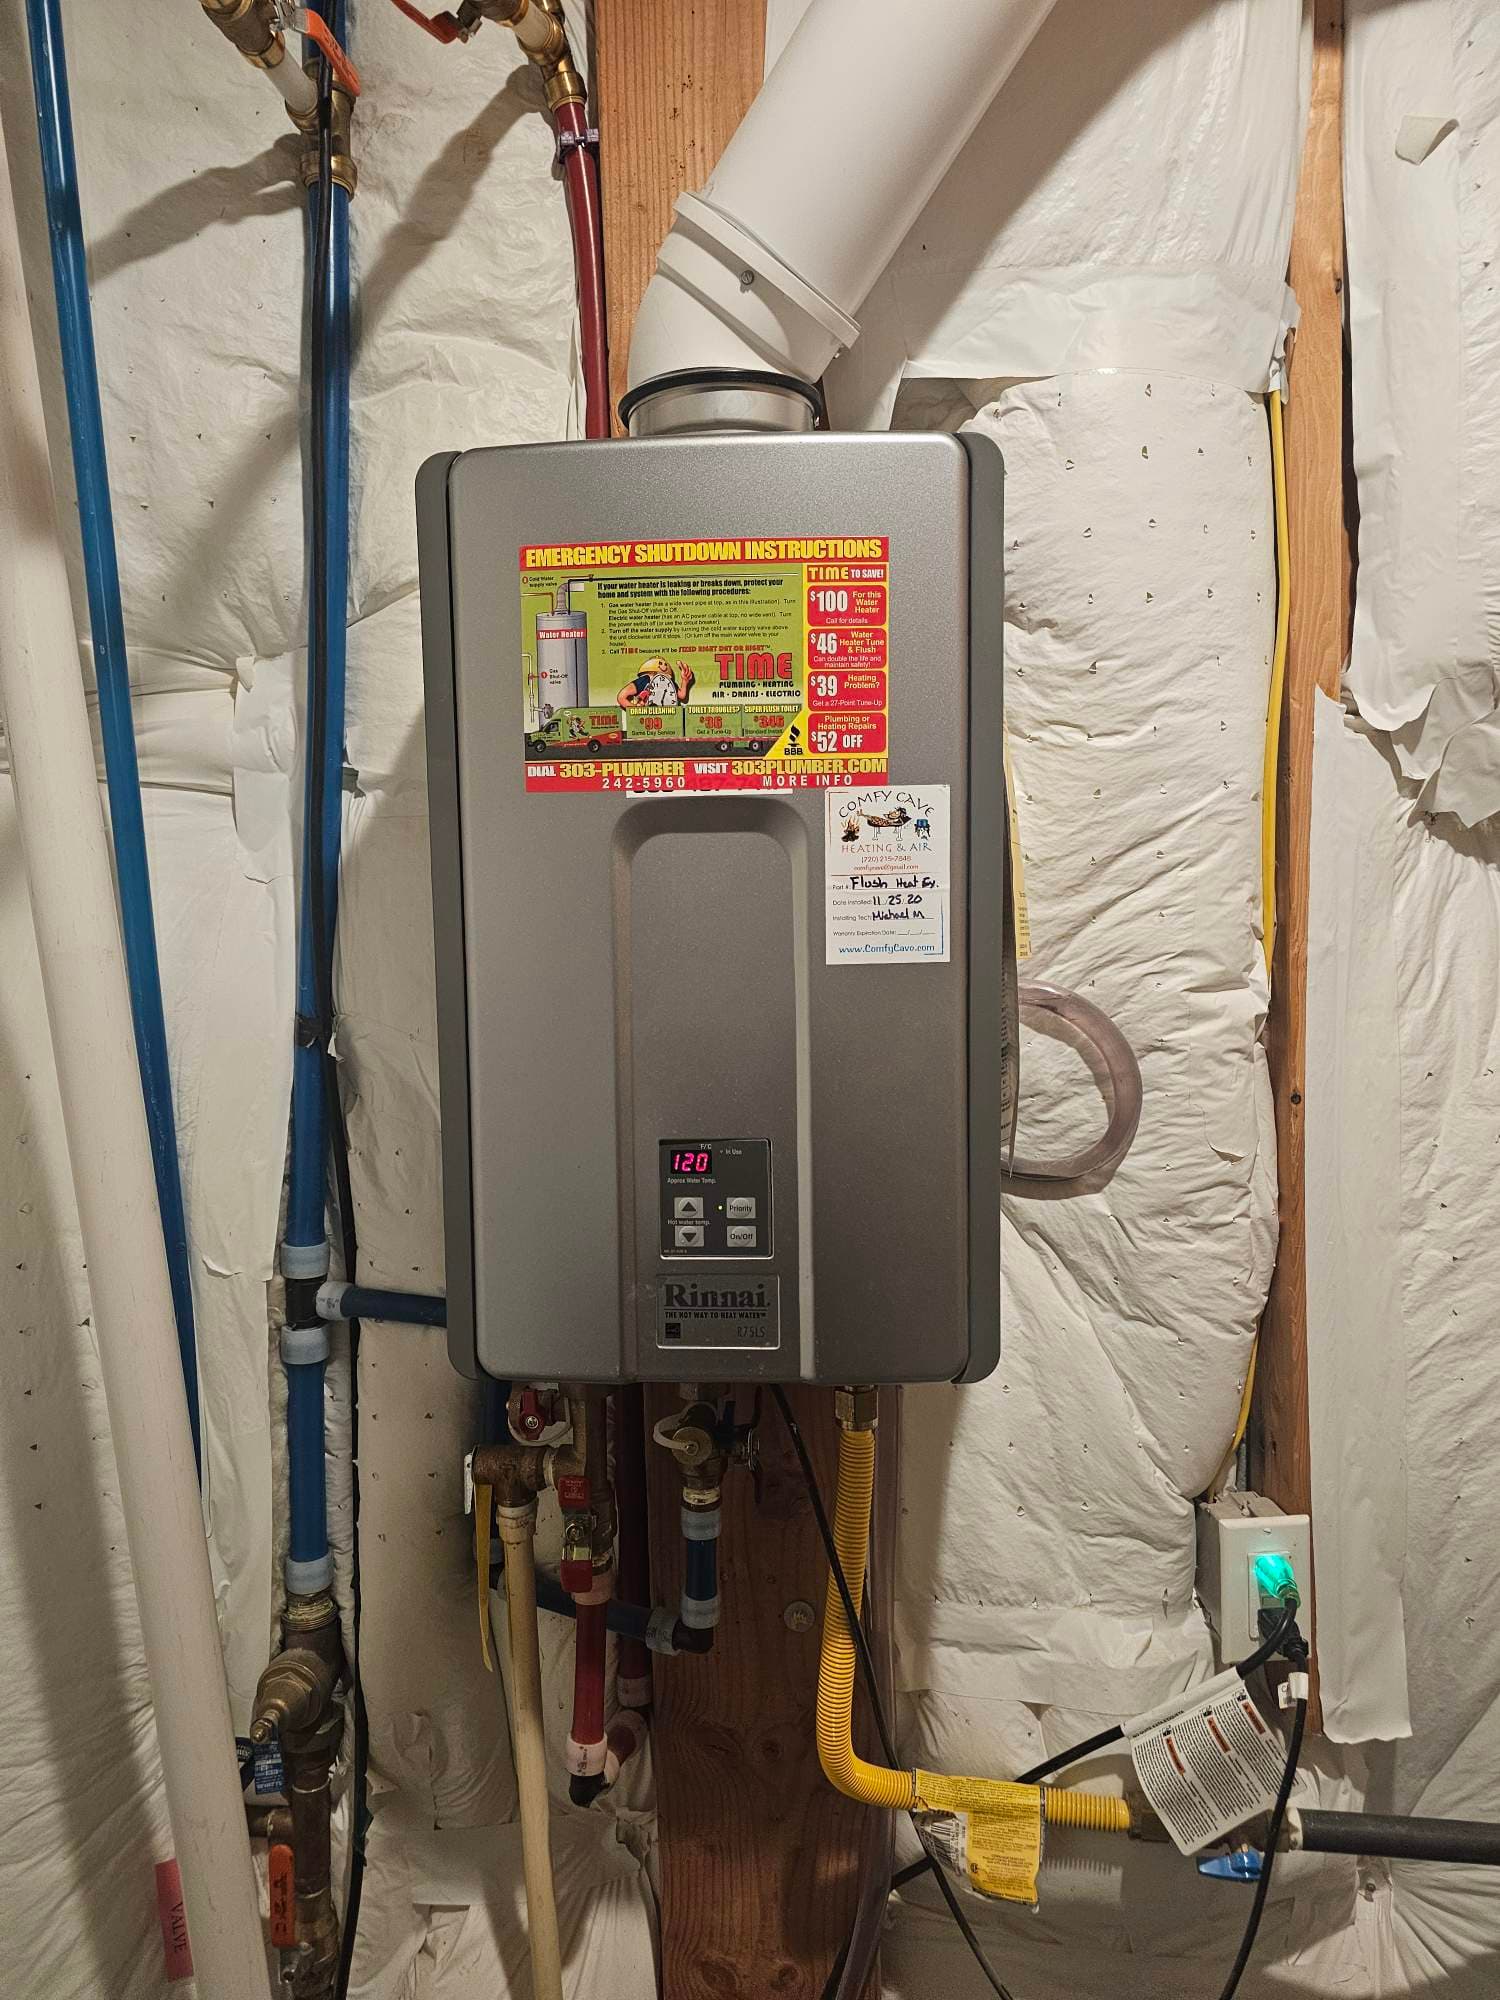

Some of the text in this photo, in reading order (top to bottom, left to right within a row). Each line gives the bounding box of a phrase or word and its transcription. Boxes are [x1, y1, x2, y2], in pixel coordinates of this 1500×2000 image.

[526, 539, 882, 567] EMERGENCY SHUTDOWN INSTRUCTIONS
[808, 567, 884, 580] TIME TO SAVE!
[604, 582, 617, 590] your
[668, 580, 691, 588] leaking
[811, 590, 848, 612] $100
[560, 630, 584, 638] Heater
[811, 632, 838, 654] $46
[714, 652, 793, 681] TIME
[848, 674, 877, 682] Heating
[811, 675, 838, 697] $39
[640, 717, 663, 730] $99
[700, 716, 723, 729] $36
[817, 723, 847, 731] Heating
[824, 715, 860, 724] Plumbing
[811, 731, 863, 753] $52 OFF
[528, 759, 886, 778] DIAL 303-PLUMBER VISIT 303PLUMBER.COM
[602, 774, 853, 788] 242-5960 MORE INFO
[838, 790, 935, 818] COMFY CAVE
[841, 842, 932, 853] HEATING & AIR
[850, 875, 888, 890] Flush
[896, 875, 918, 888] Heat
[872, 908, 925, 920] Michael M
[673, 1152, 708, 1172] 120
[664, 1283, 767, 1307] Rinnai
[170, 1901, 187, 1953] VALVE
